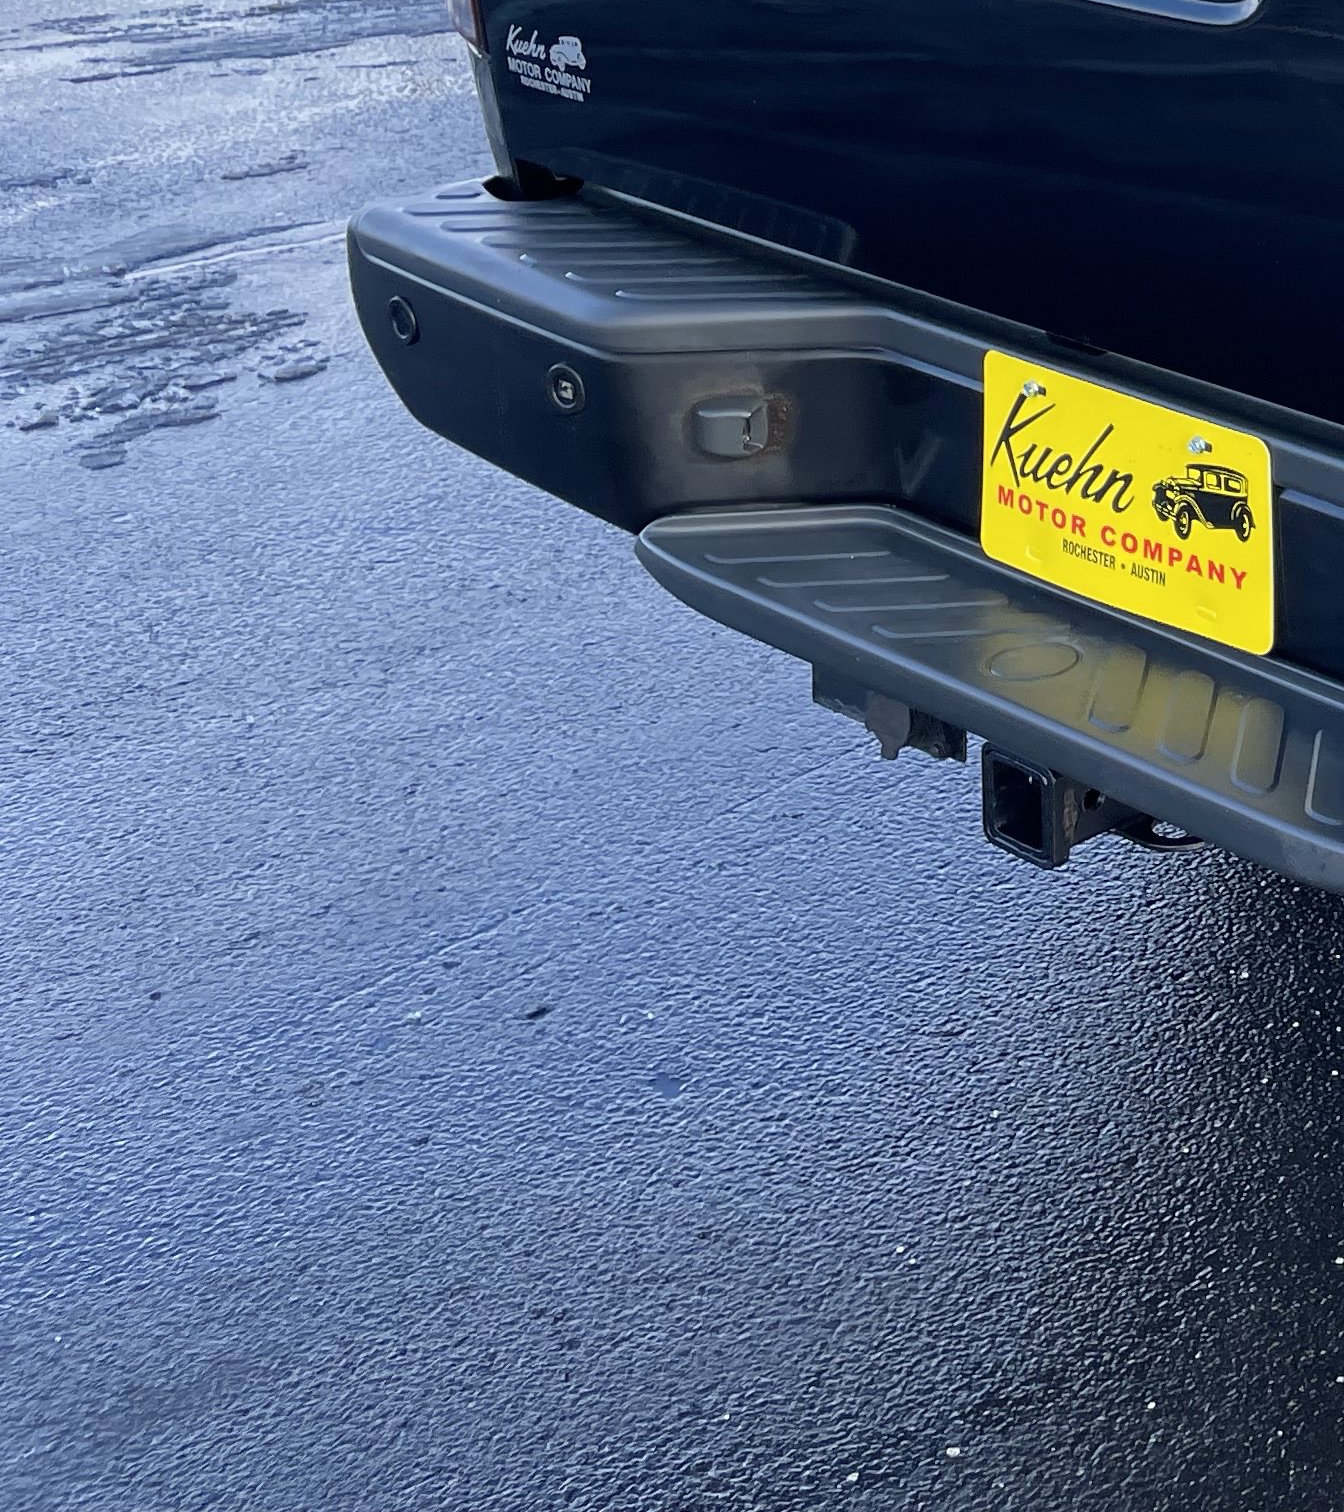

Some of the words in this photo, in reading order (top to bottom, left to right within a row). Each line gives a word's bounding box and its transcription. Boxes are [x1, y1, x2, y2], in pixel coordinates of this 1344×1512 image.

[505, 24, 547, 61] Kuehn
[507, 56, 542, 80] MOTOR
[544, 67, 592, 94] COMPANY
[989, 391, 1136, 514] Kuehn
[997, 484, 1087, 539] MOTOR
[1100, 525, 1249, 591] COMPANY
[1062, 538, 1117, 570] ROCHESTER
[1130, 563, 1167, 587] AUSTIN
